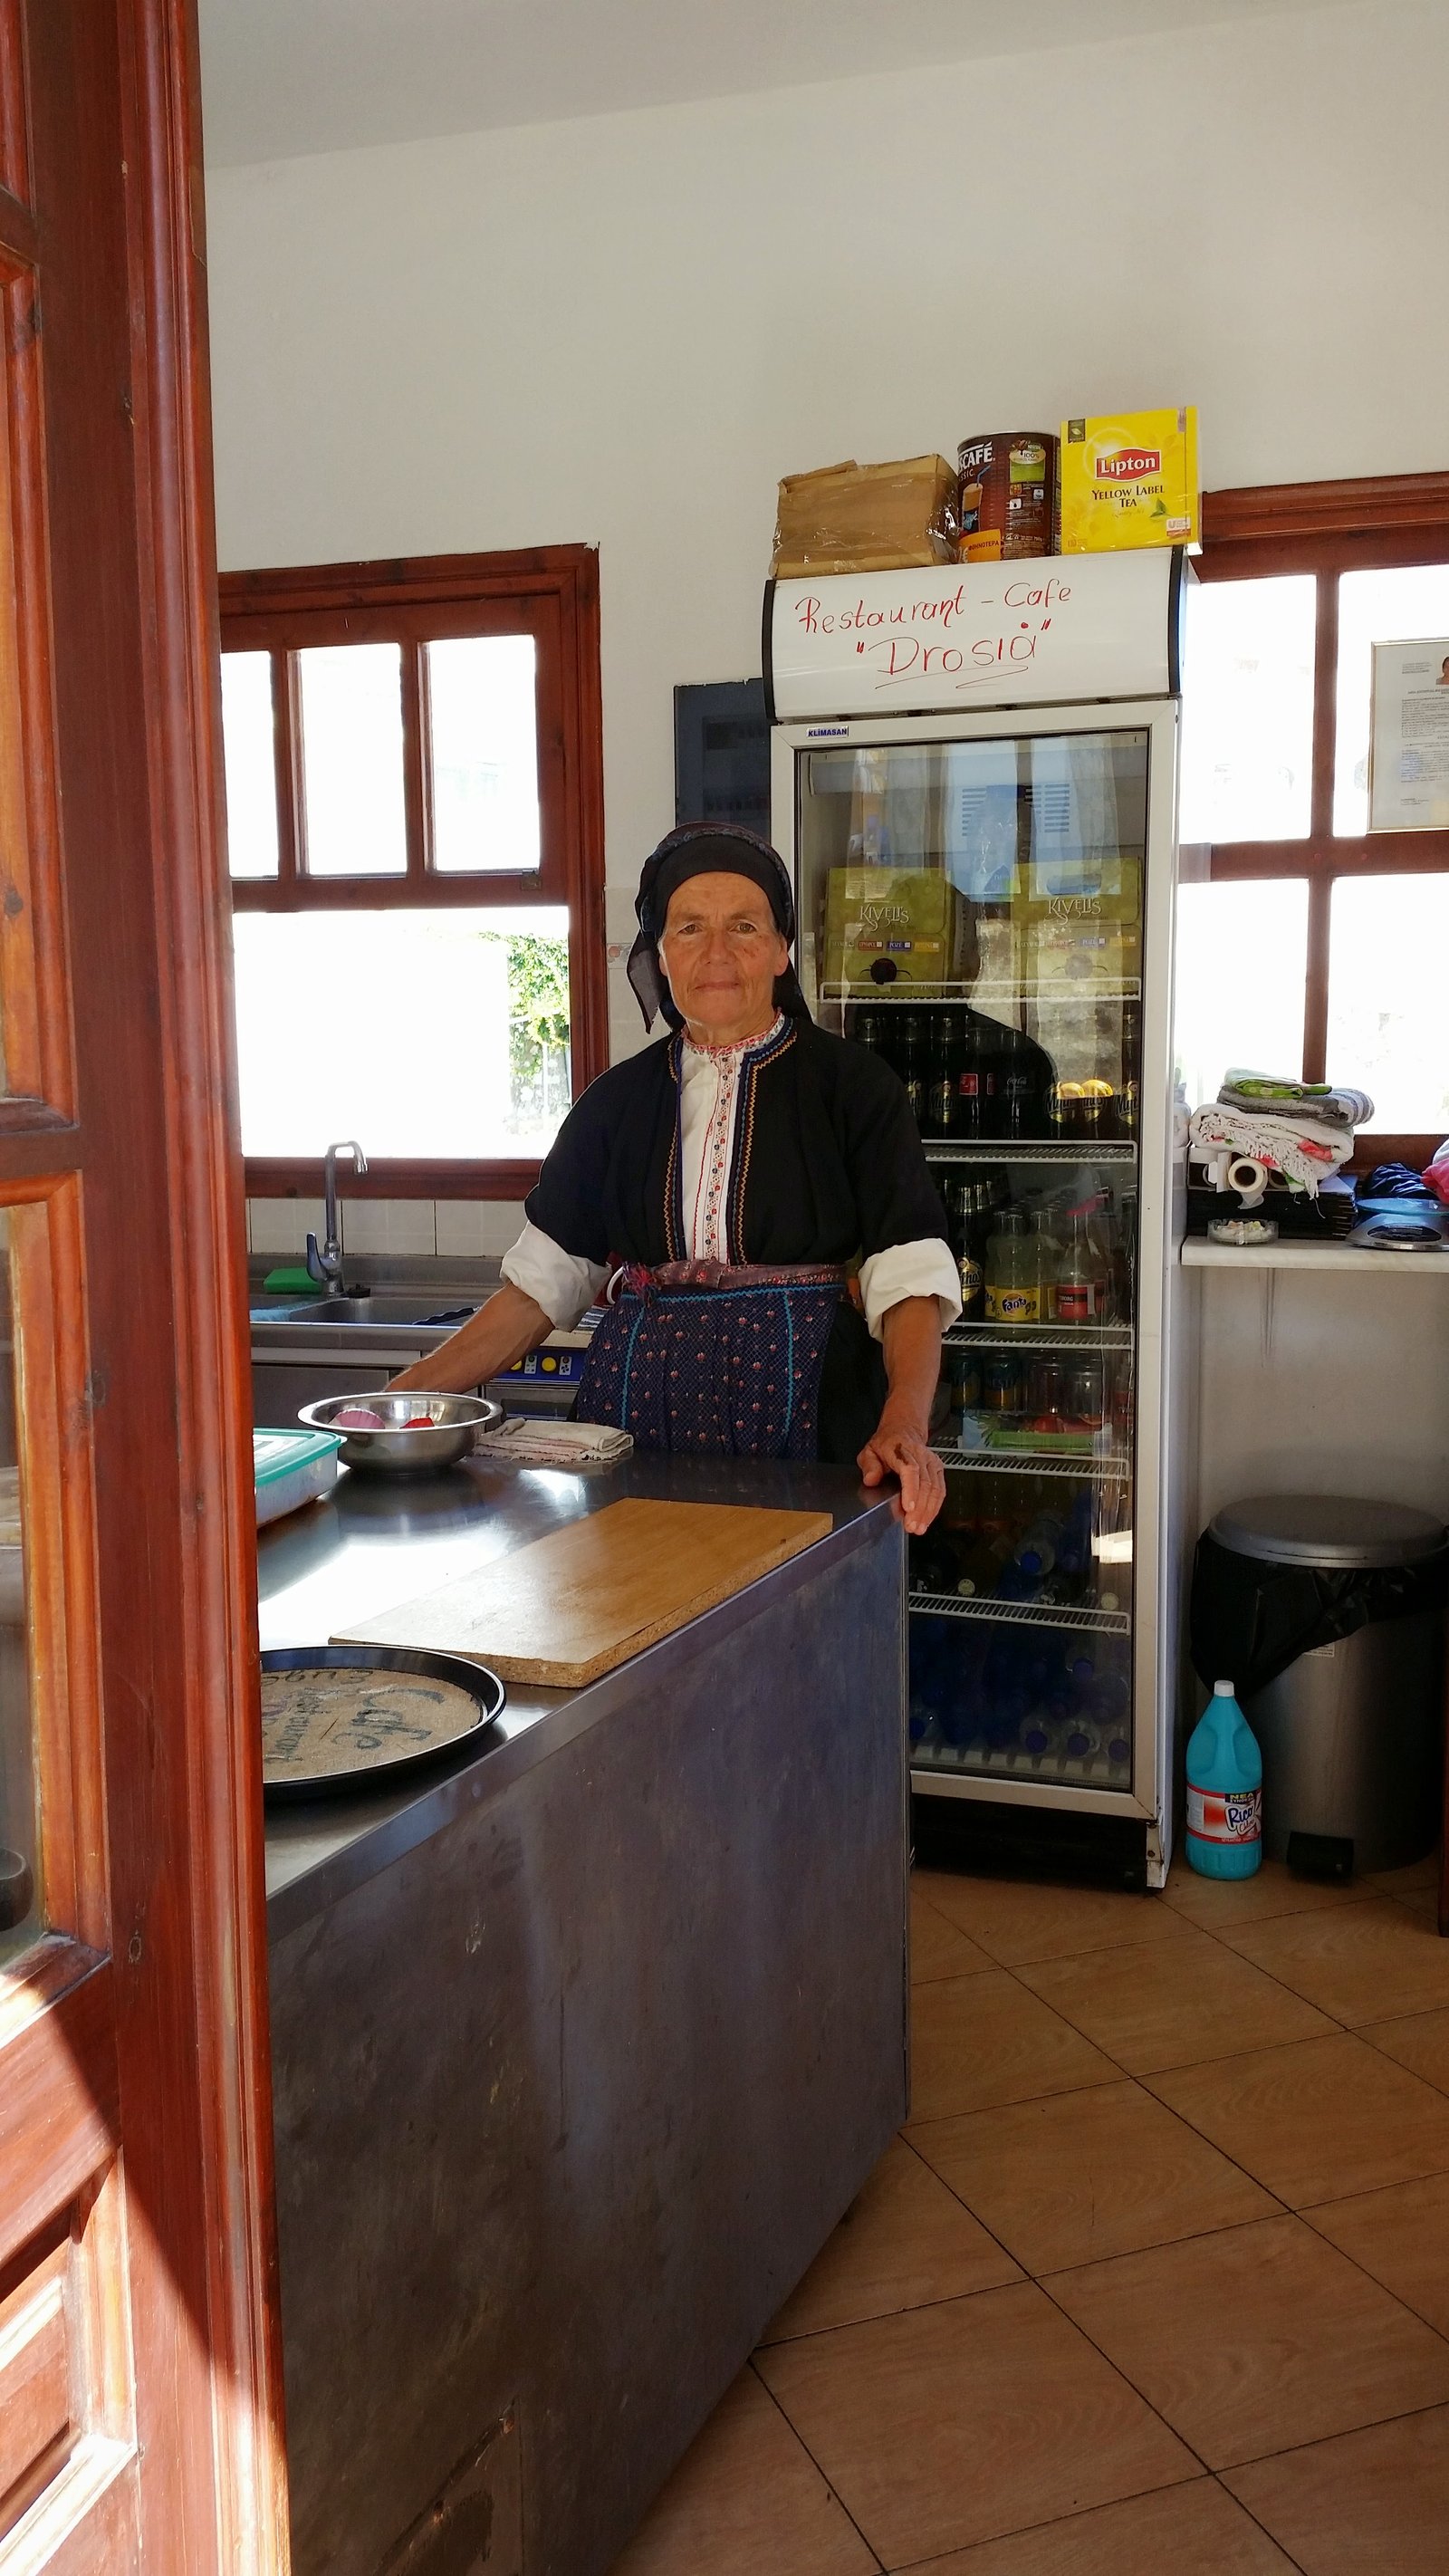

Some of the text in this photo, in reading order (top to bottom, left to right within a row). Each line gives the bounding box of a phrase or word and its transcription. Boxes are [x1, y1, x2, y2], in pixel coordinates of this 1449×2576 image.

[1100, 457, 1156, 476] Lipton
[1091, 485, 1165, 501] YELLOW LABEL
[1119, 498, 1137, 508] TEA
[795, 585, 966, 633] Restaurant
[1003, 579, 1071, 608] Cafe
[1002, 1297, 1027, 1312] Fanta
[1228, 1806, 1253, 1829] Rico
